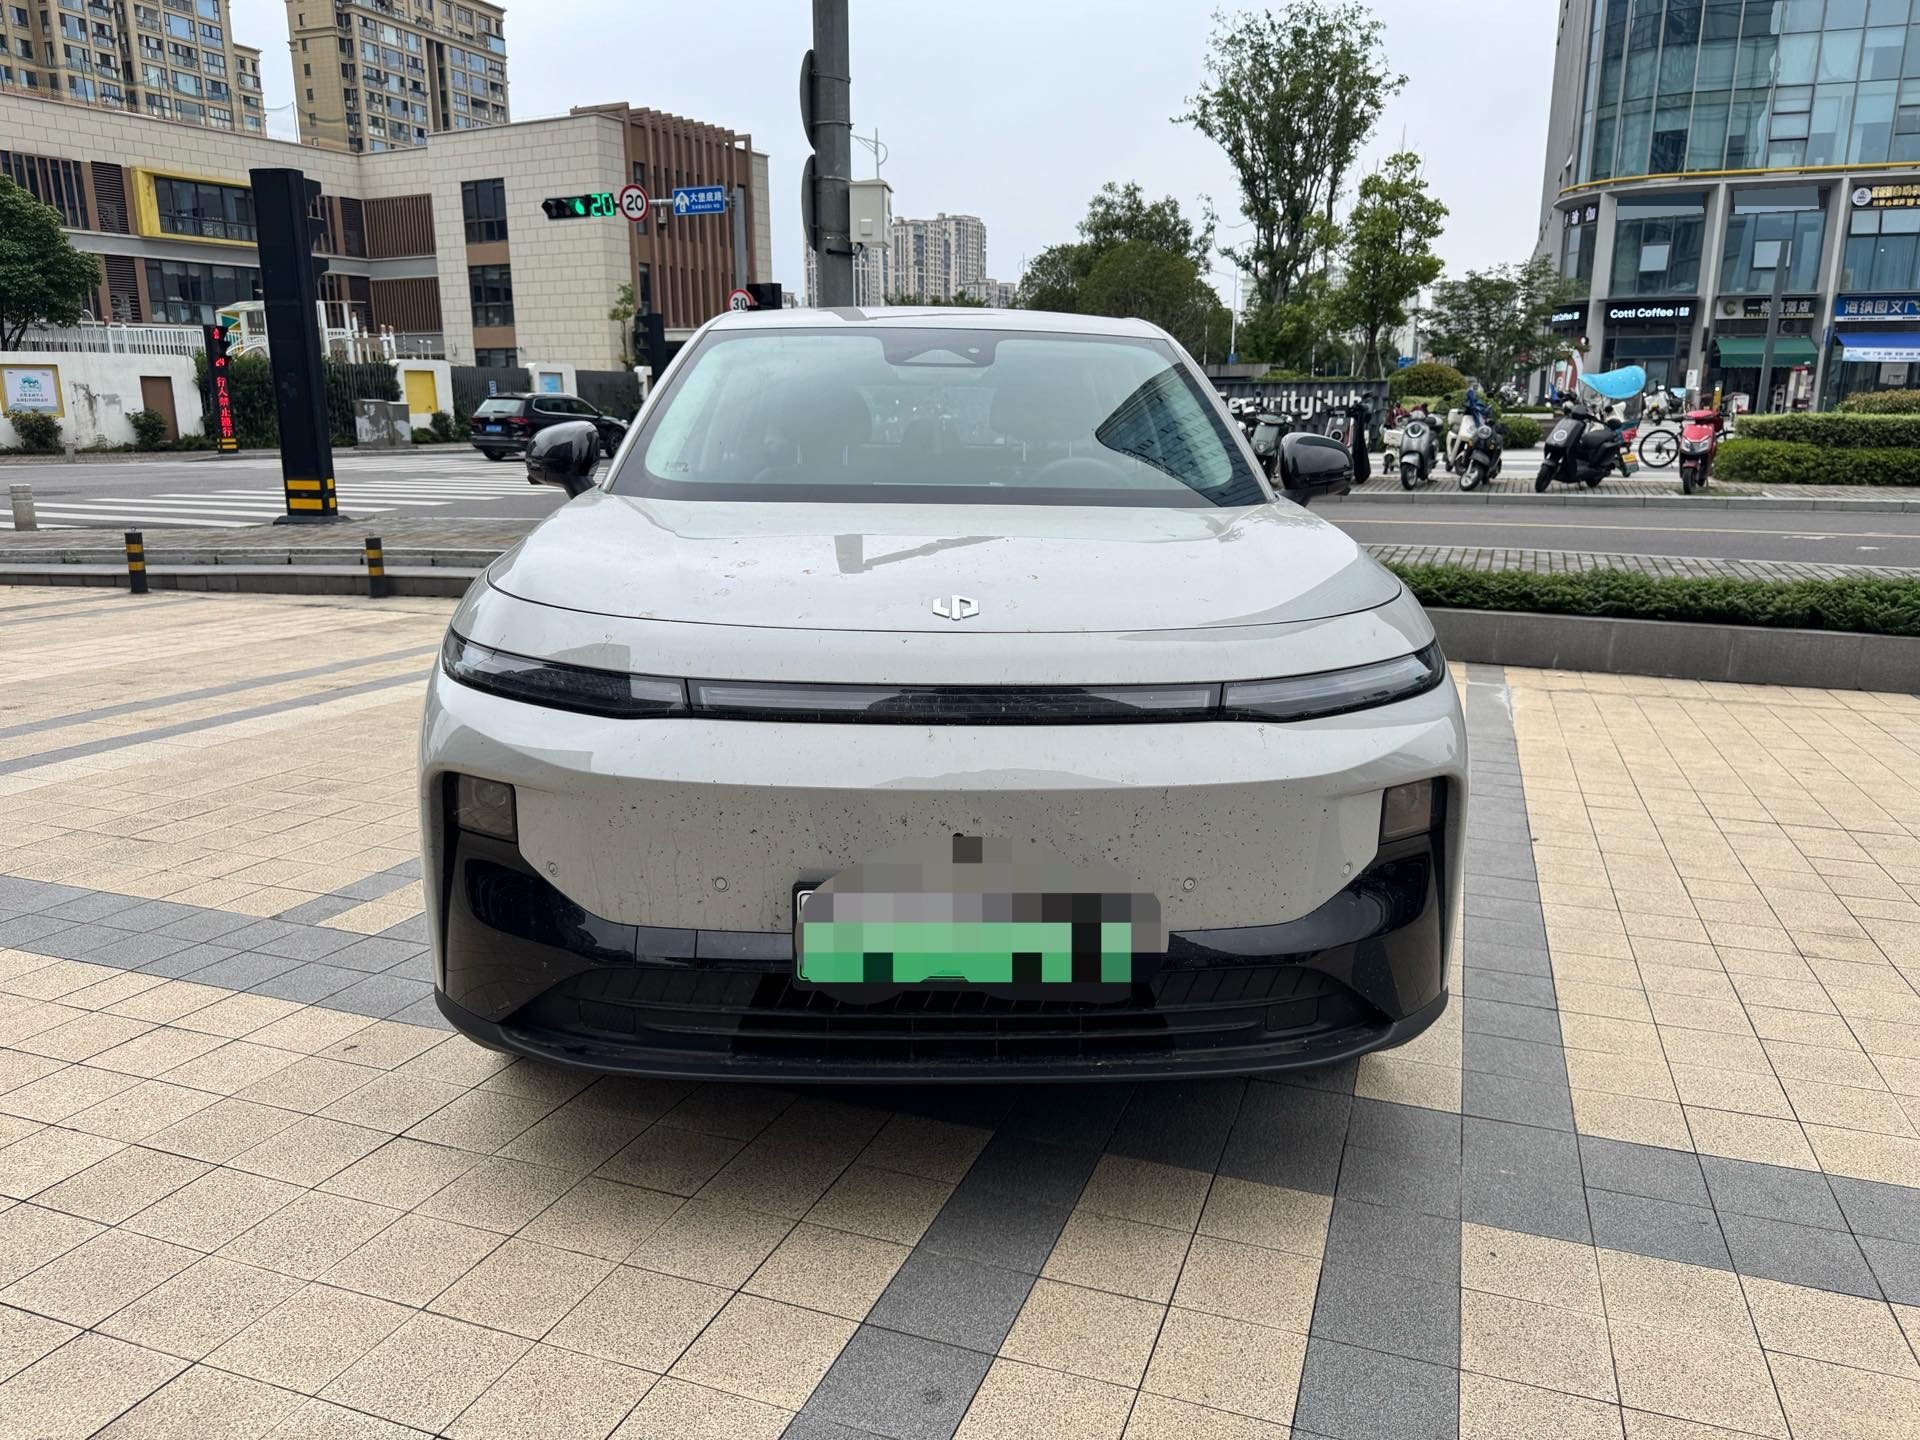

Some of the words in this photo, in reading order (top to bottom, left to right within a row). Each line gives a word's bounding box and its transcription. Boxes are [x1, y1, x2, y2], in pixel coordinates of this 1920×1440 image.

[590, 193, 615, 217] 20
[625, 194, 644, 212] 20
[732, 297, 748, 311] 30
[1610, 308, 1636, 319] Cotti
[1636, 307, 1674, 318] Coffee
[216, 376, 233, 438] 行人禁止通行
